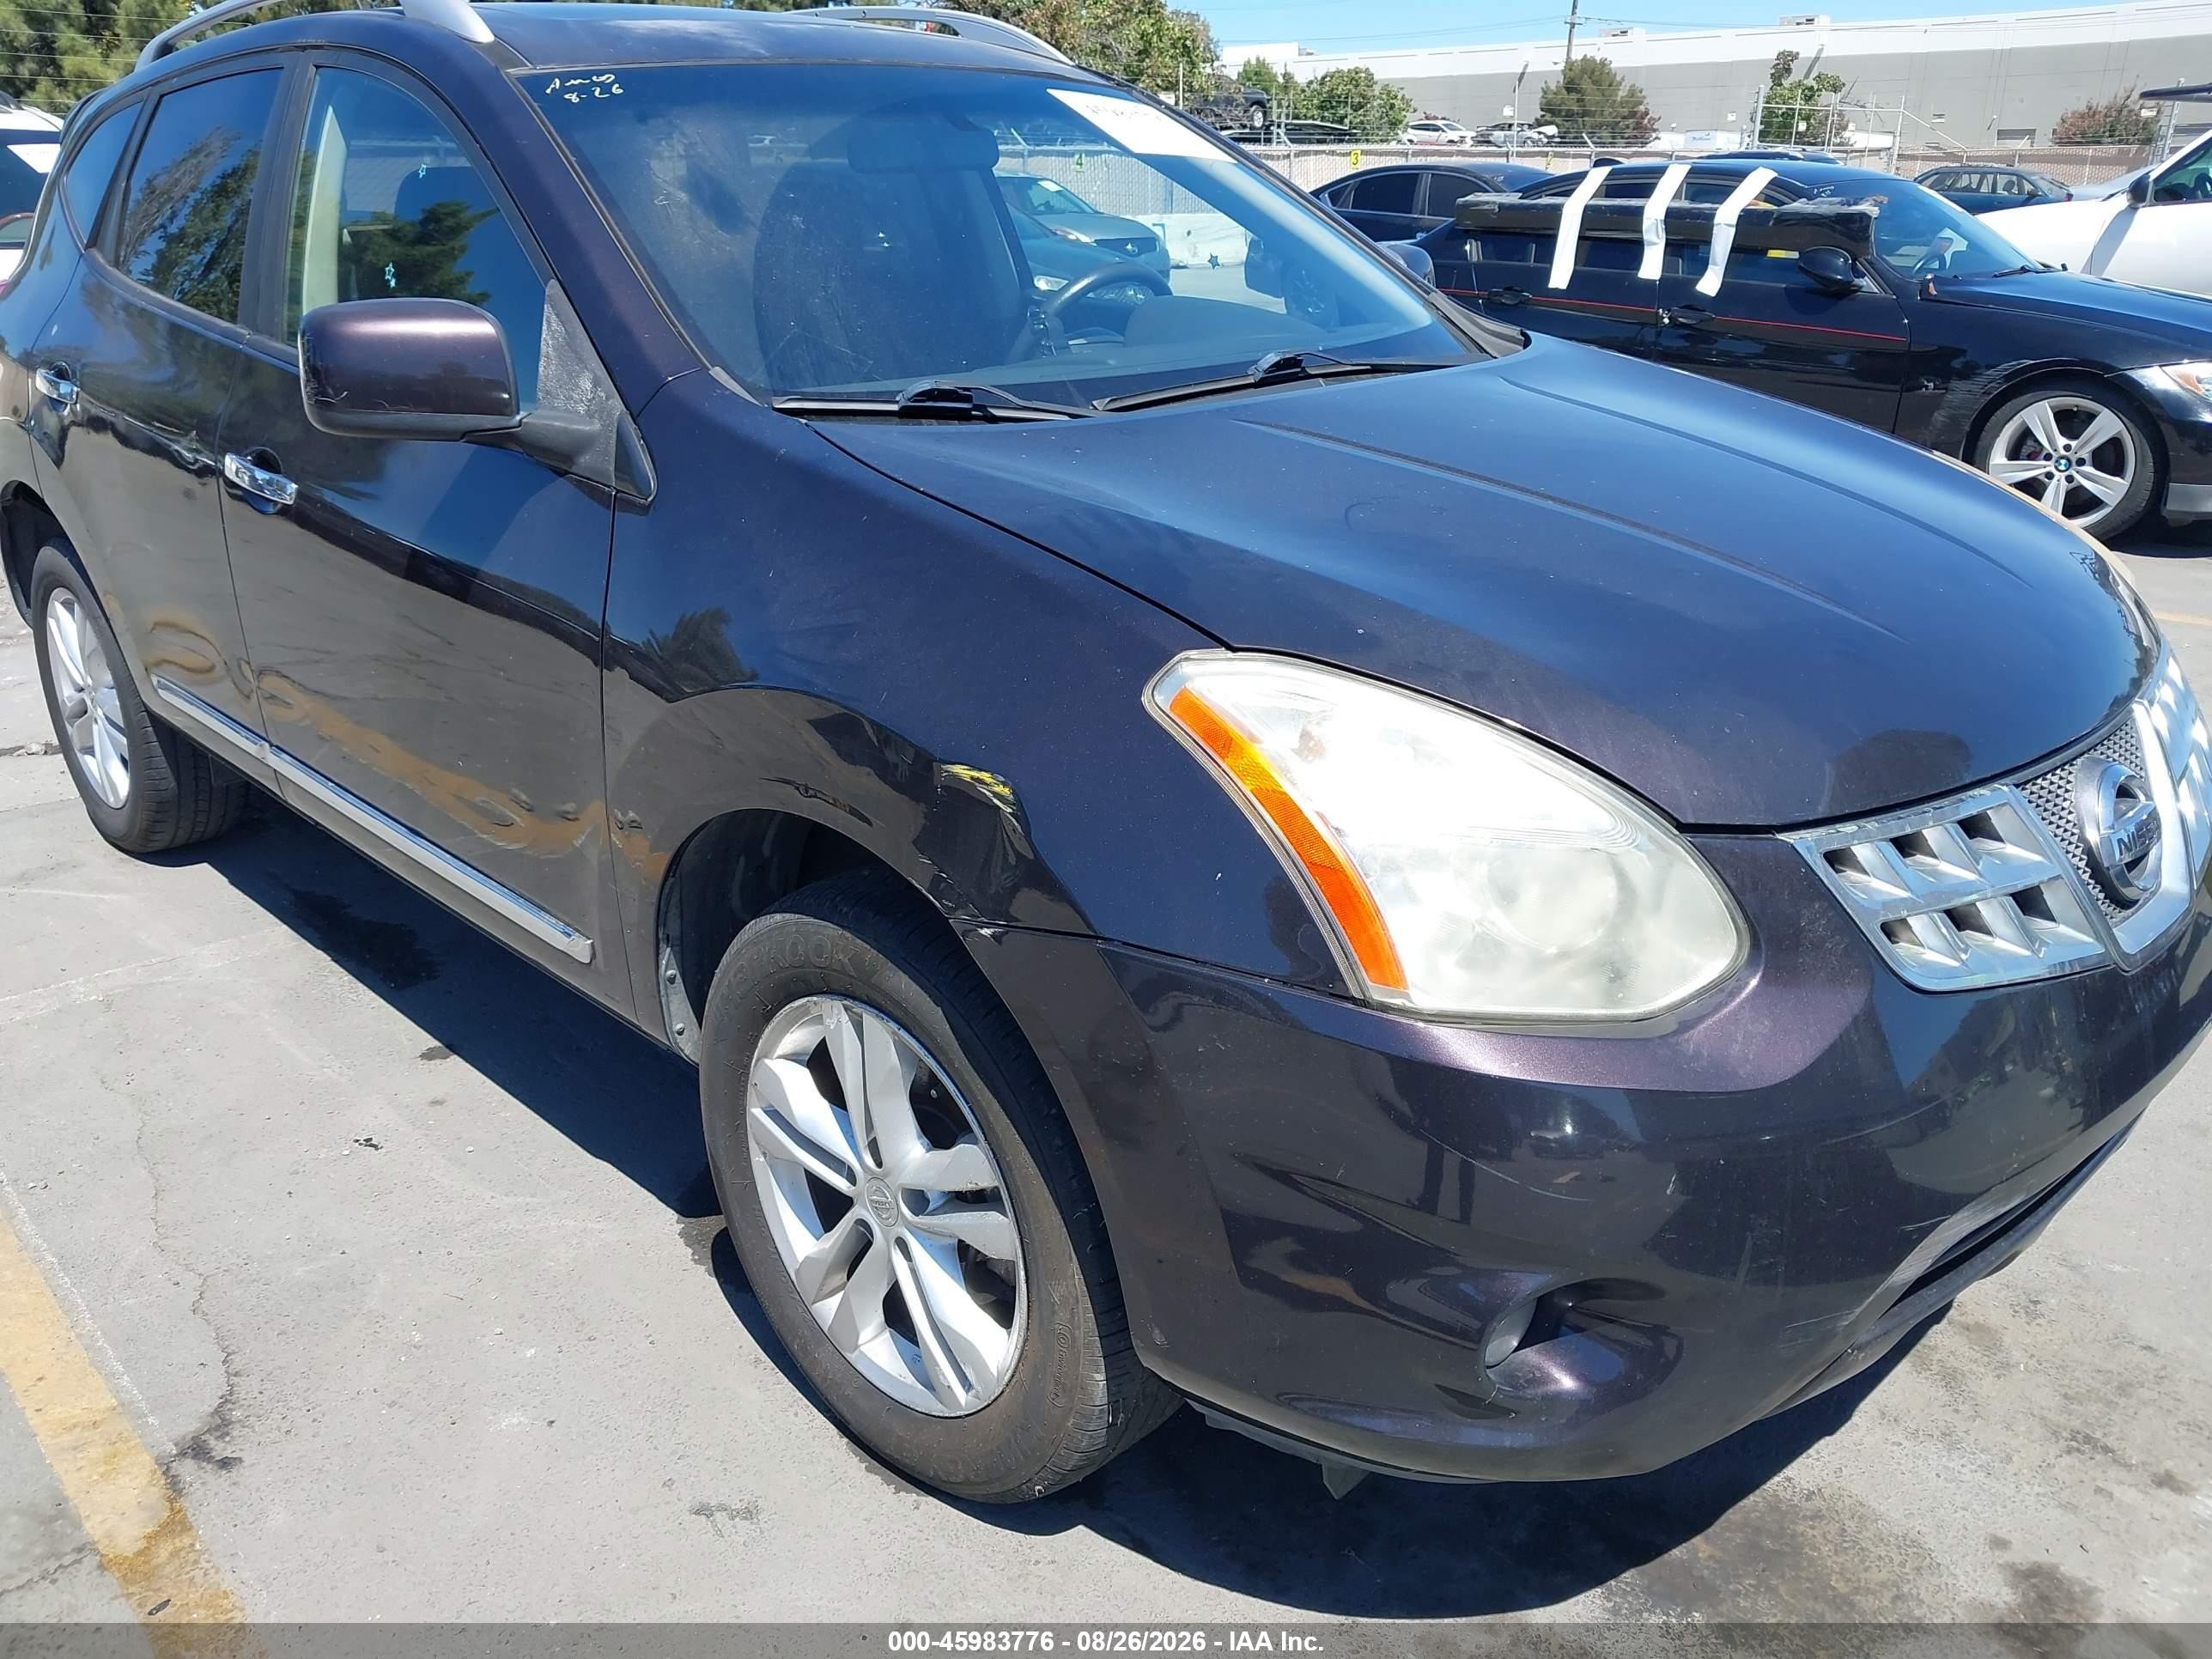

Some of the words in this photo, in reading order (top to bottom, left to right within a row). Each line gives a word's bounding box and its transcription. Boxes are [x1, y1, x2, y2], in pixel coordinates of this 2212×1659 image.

[563, 83, 625, 103] 8-26
[1075, 152, 1085, 169] 4
[1352, 152, 1359, 166] 3
